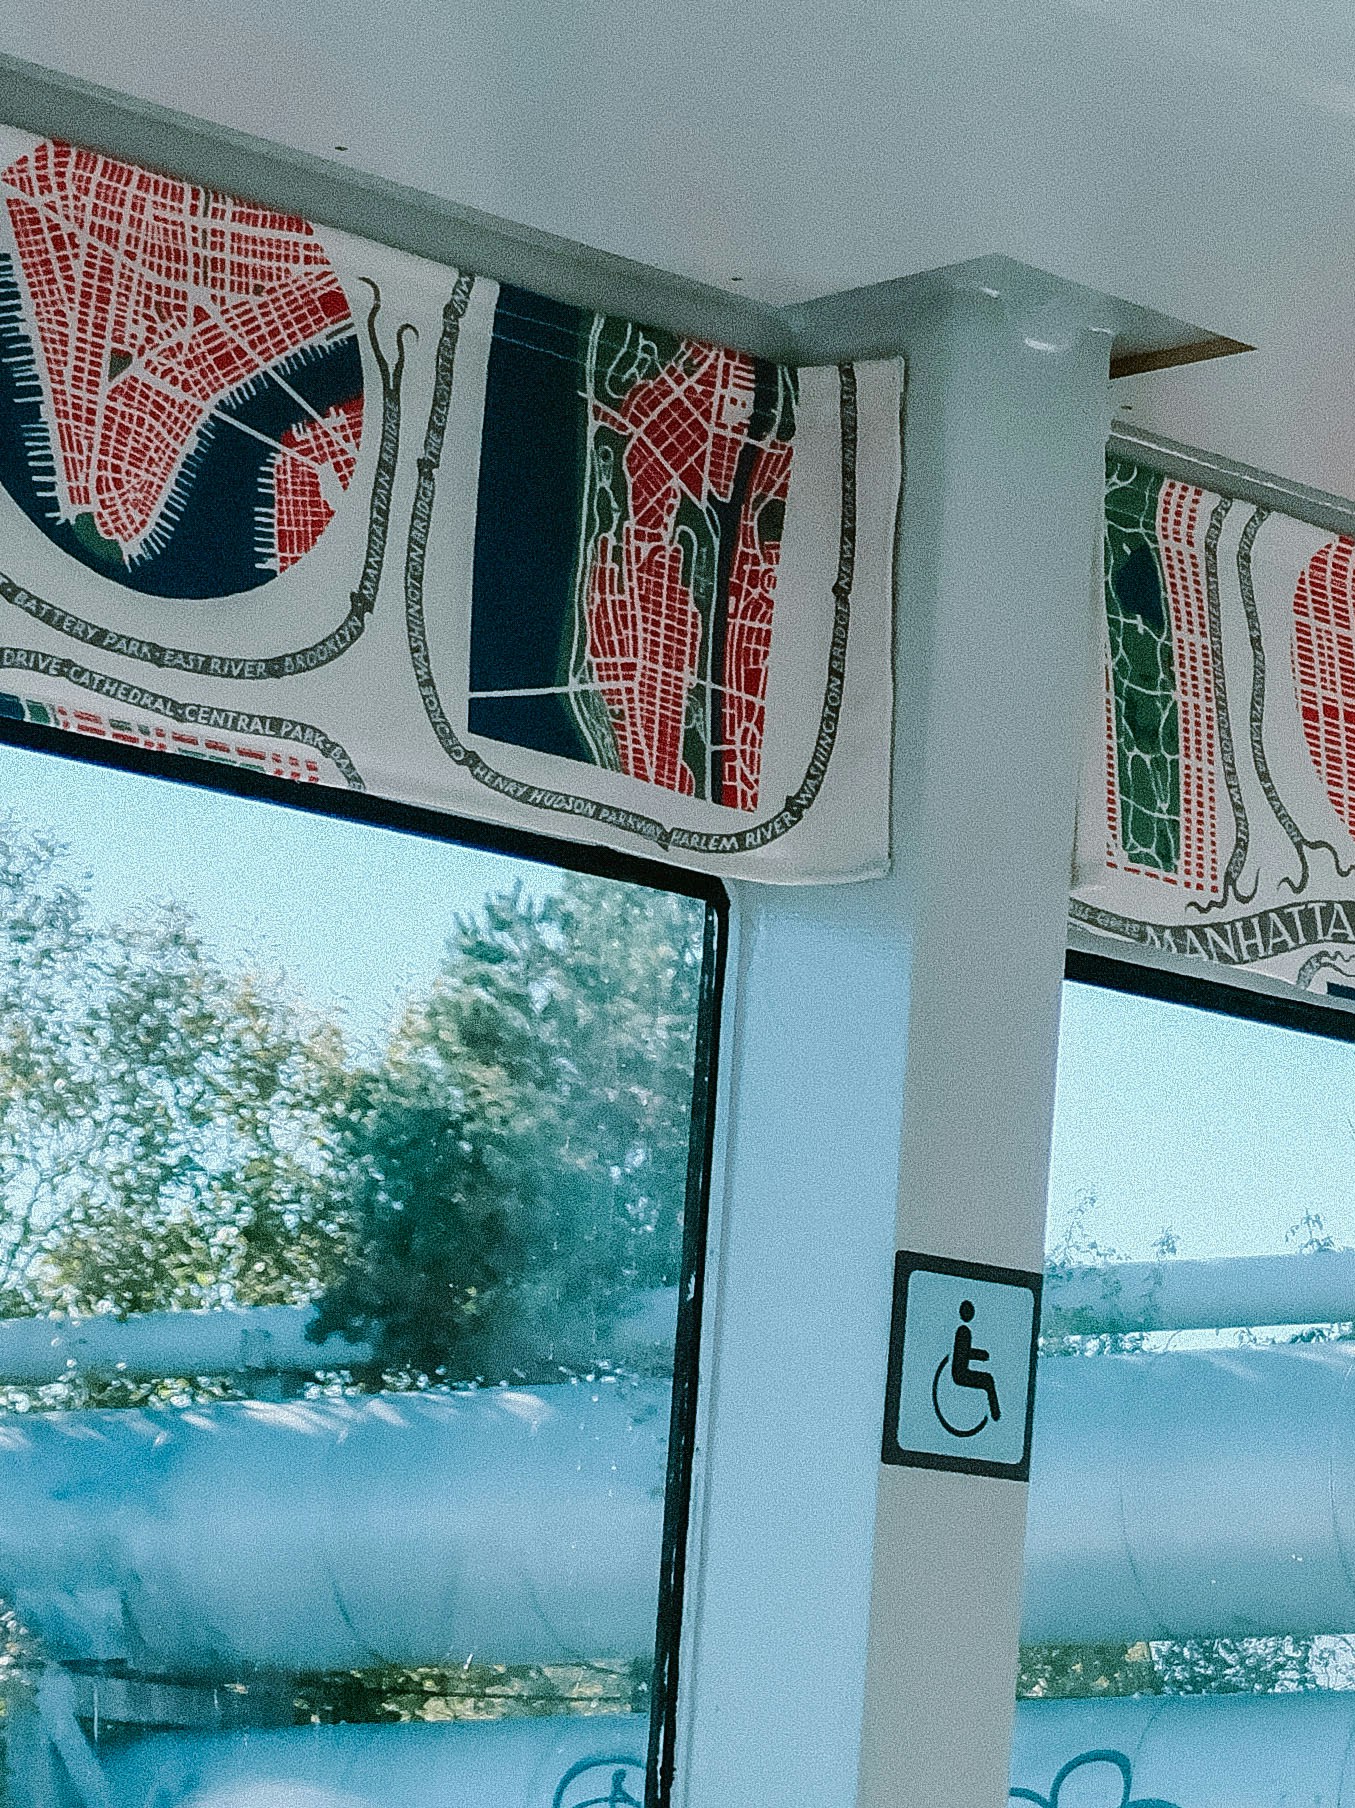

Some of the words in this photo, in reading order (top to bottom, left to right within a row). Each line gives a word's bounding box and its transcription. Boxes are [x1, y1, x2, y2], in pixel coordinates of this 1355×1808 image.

[13, 591, 97, 644] BATTERY
[103, 635, 154, 658] PARK
[164, 649, 206, 672] EAST
[209, 657, 267, 678] RIVER
[284, 617, 362, 673] BROOKLYN
[361, 470, 391, 601] MANHATTAN
[382, 398, 398, 464] BRIDGE
[410, 476, 434, 543] BRIDGE
[842, 476, 855, 530] YORK
[838, 536, 854, 589] NEW
[406, 544, 430, 682] WASHINGTON
[3, 649, 62, 675] DRIVE
[68, 666, 176, 717] CATHEDRAL
[183, 704, 275, 736] CENTRAL
[280, 723, 326, 749] PARK
[419, 685, 467, 761] GEORGE
[473, 761, 525, 797] HENRY
[529, 785, 596, 817] HUDSON
[670, 827, 739, 853] HARLEM
[745, 811, 797, 851] RIVER
[797, 676, 842, 809] WASHINGTON
[830, 602, 849, 672] BRIDGE
